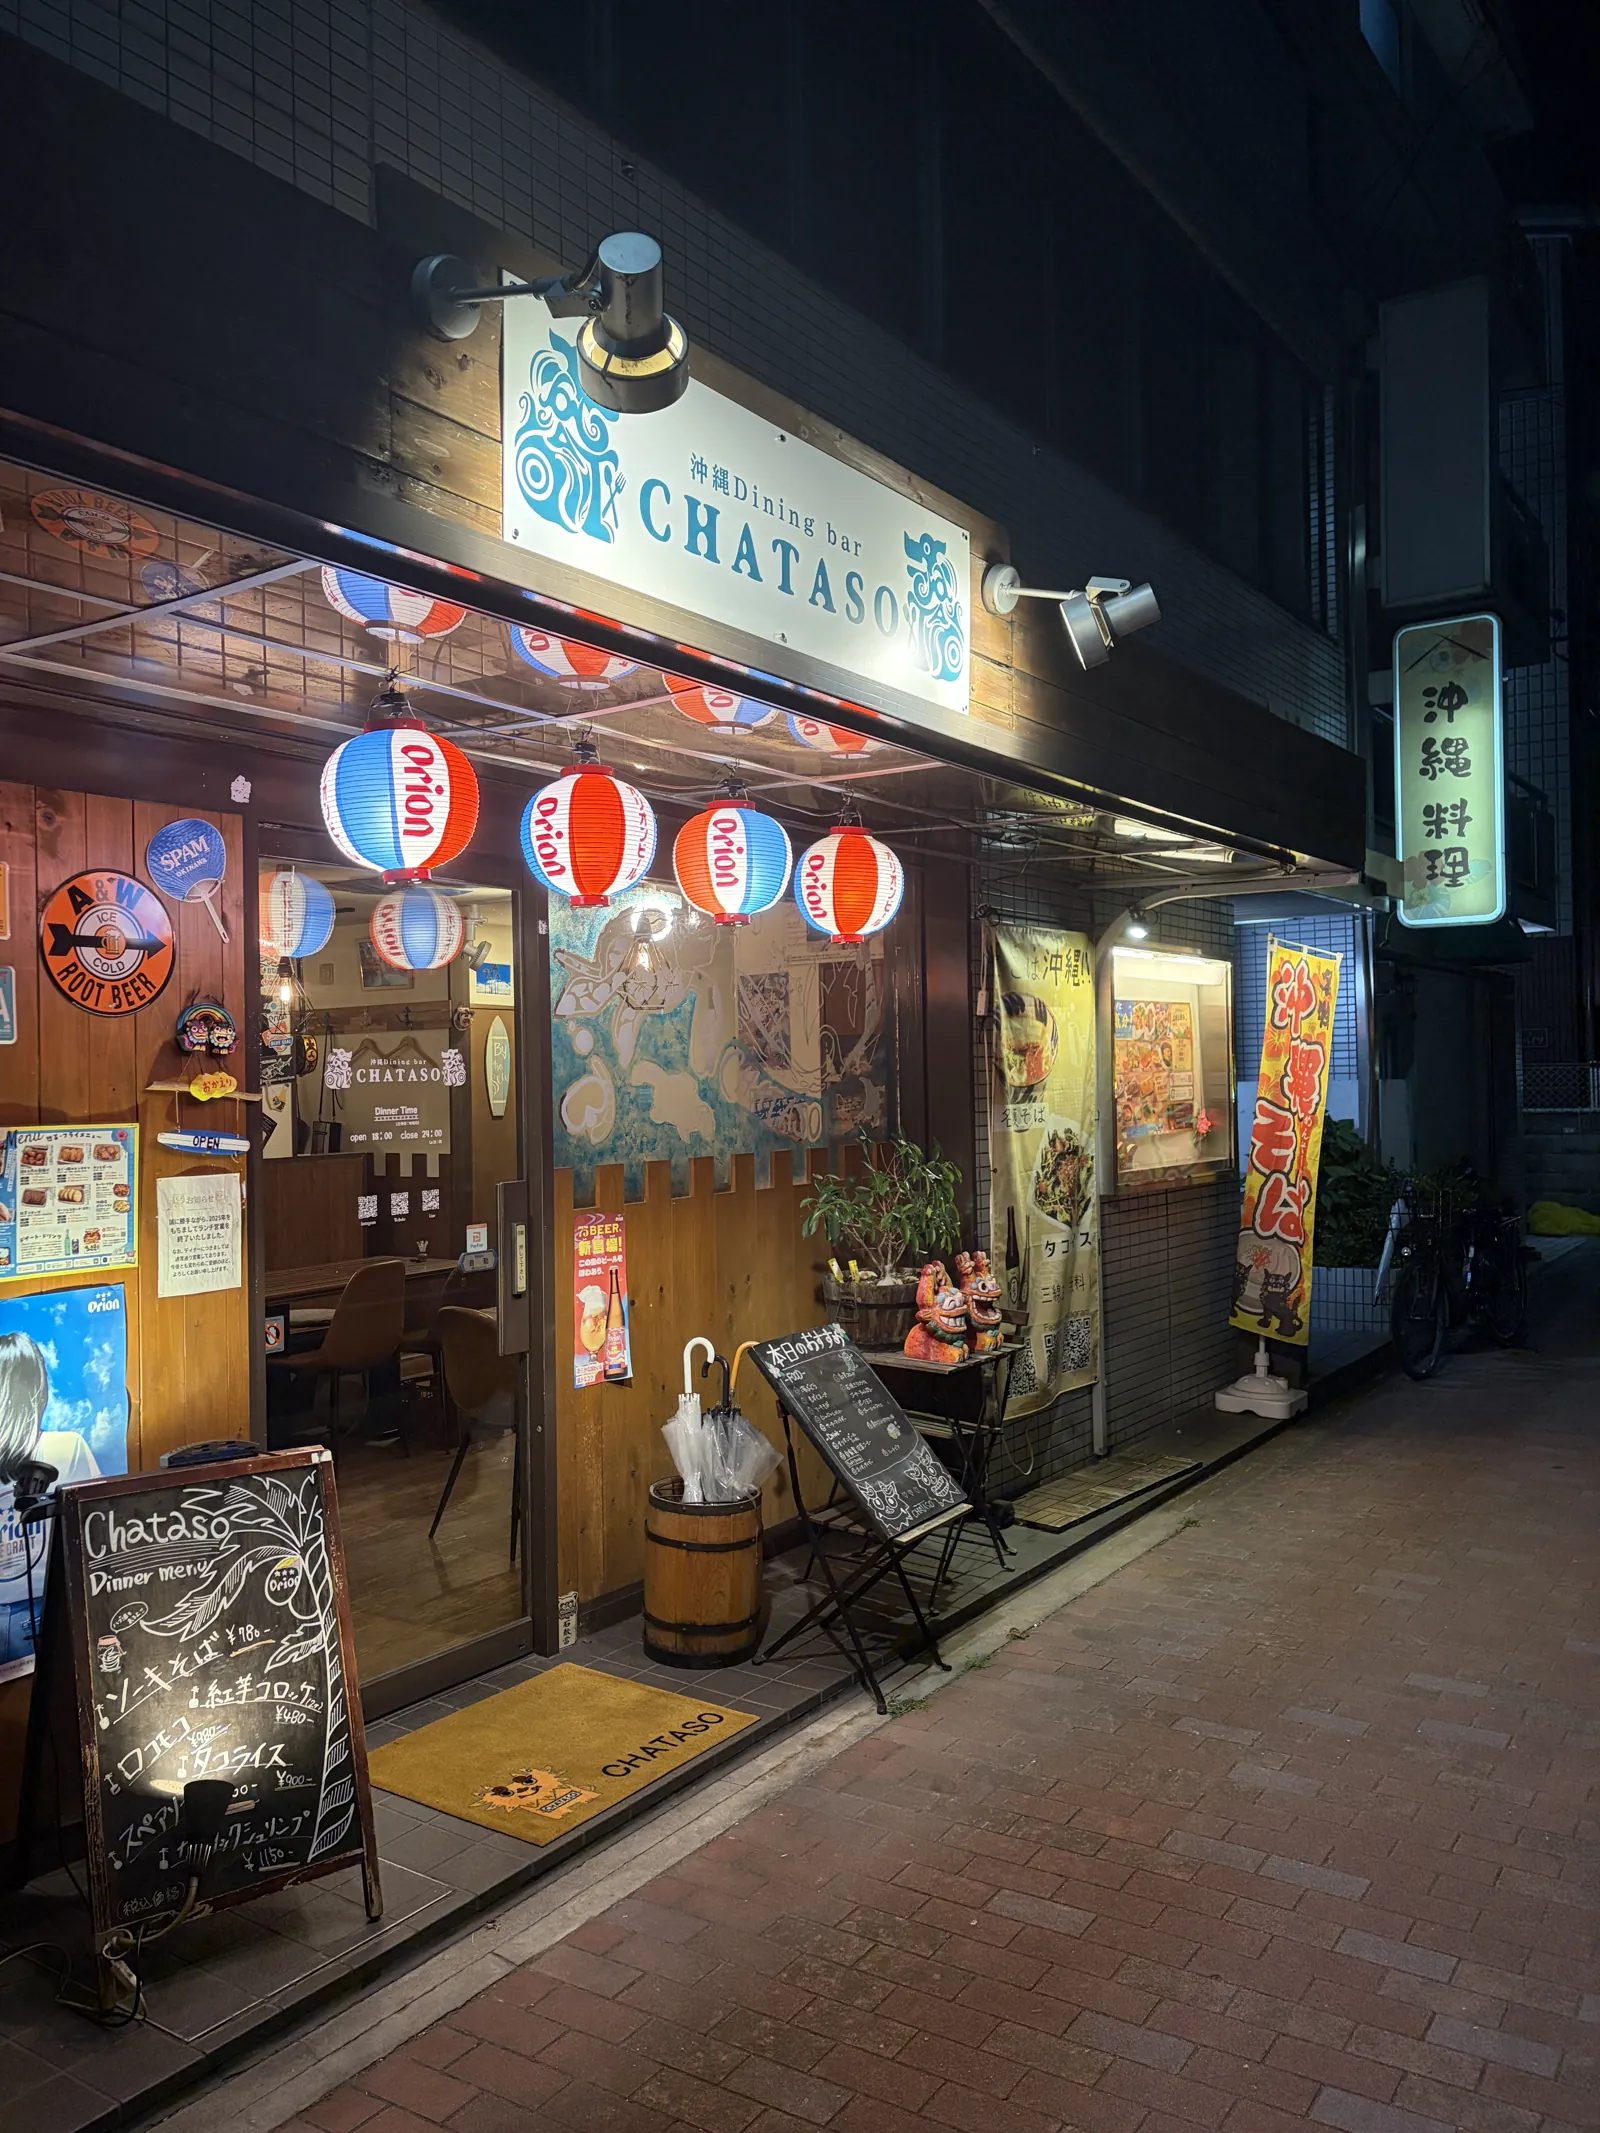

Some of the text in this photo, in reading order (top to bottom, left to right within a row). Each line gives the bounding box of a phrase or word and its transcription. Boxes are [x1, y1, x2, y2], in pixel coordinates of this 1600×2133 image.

[690, 452, 862, 557] 沖縄Dining bar
[639, 478, 899, 638] CHATASO
[401, 744, 444, 837] Orion
[1419, 681, 1473, 887] 沖縄料理
[160, 835, 210, 872] SPAM
[535, 797, 567, 877] Orion
[713, 818, 745, 888] Orion
[176, 857, 208, 877] OKINAWA
[67, 878, 145, 916] A&W
[807, 854, 828, 919] Orion
[97, 911, 117, 924] ICE
[93, 958, 125, 973] COLD
[57, 961, 105, 1006] ROOT
[112, 972, 156, 1009] BEER
[413, 1058, 427, 1066] bar
[494, 1043, 507, 1060] By
[203, 1077, 232, 1093] おかえり
[356, 1067, 441, 1083] CHATASO
[374, 1105, 418, 1116] Dinner Time
[1252, 959, 1323, 1246] 沖縄そば
[6, 1130, 43, 1148] Menu
[192, 1135, 220, 1149] OPEN
[350, 1129, 443, 1143] open 18:00 close 24:00
[87, 1297, 120, 1313] Orion
[766, 1328, 846, 1368] 本日のおすすめ
[85, 1510, 230, 1559] Chataso
[90, 1560, 207, 1597] Dinner menu
[106, 1630, 221, 1714] ソーキそば
[117, 1716, 192, 1781] ロコモコ
[191, 1743, 288, 1780] タコライス
[601, 1711, 725, 1778] CHATASO
